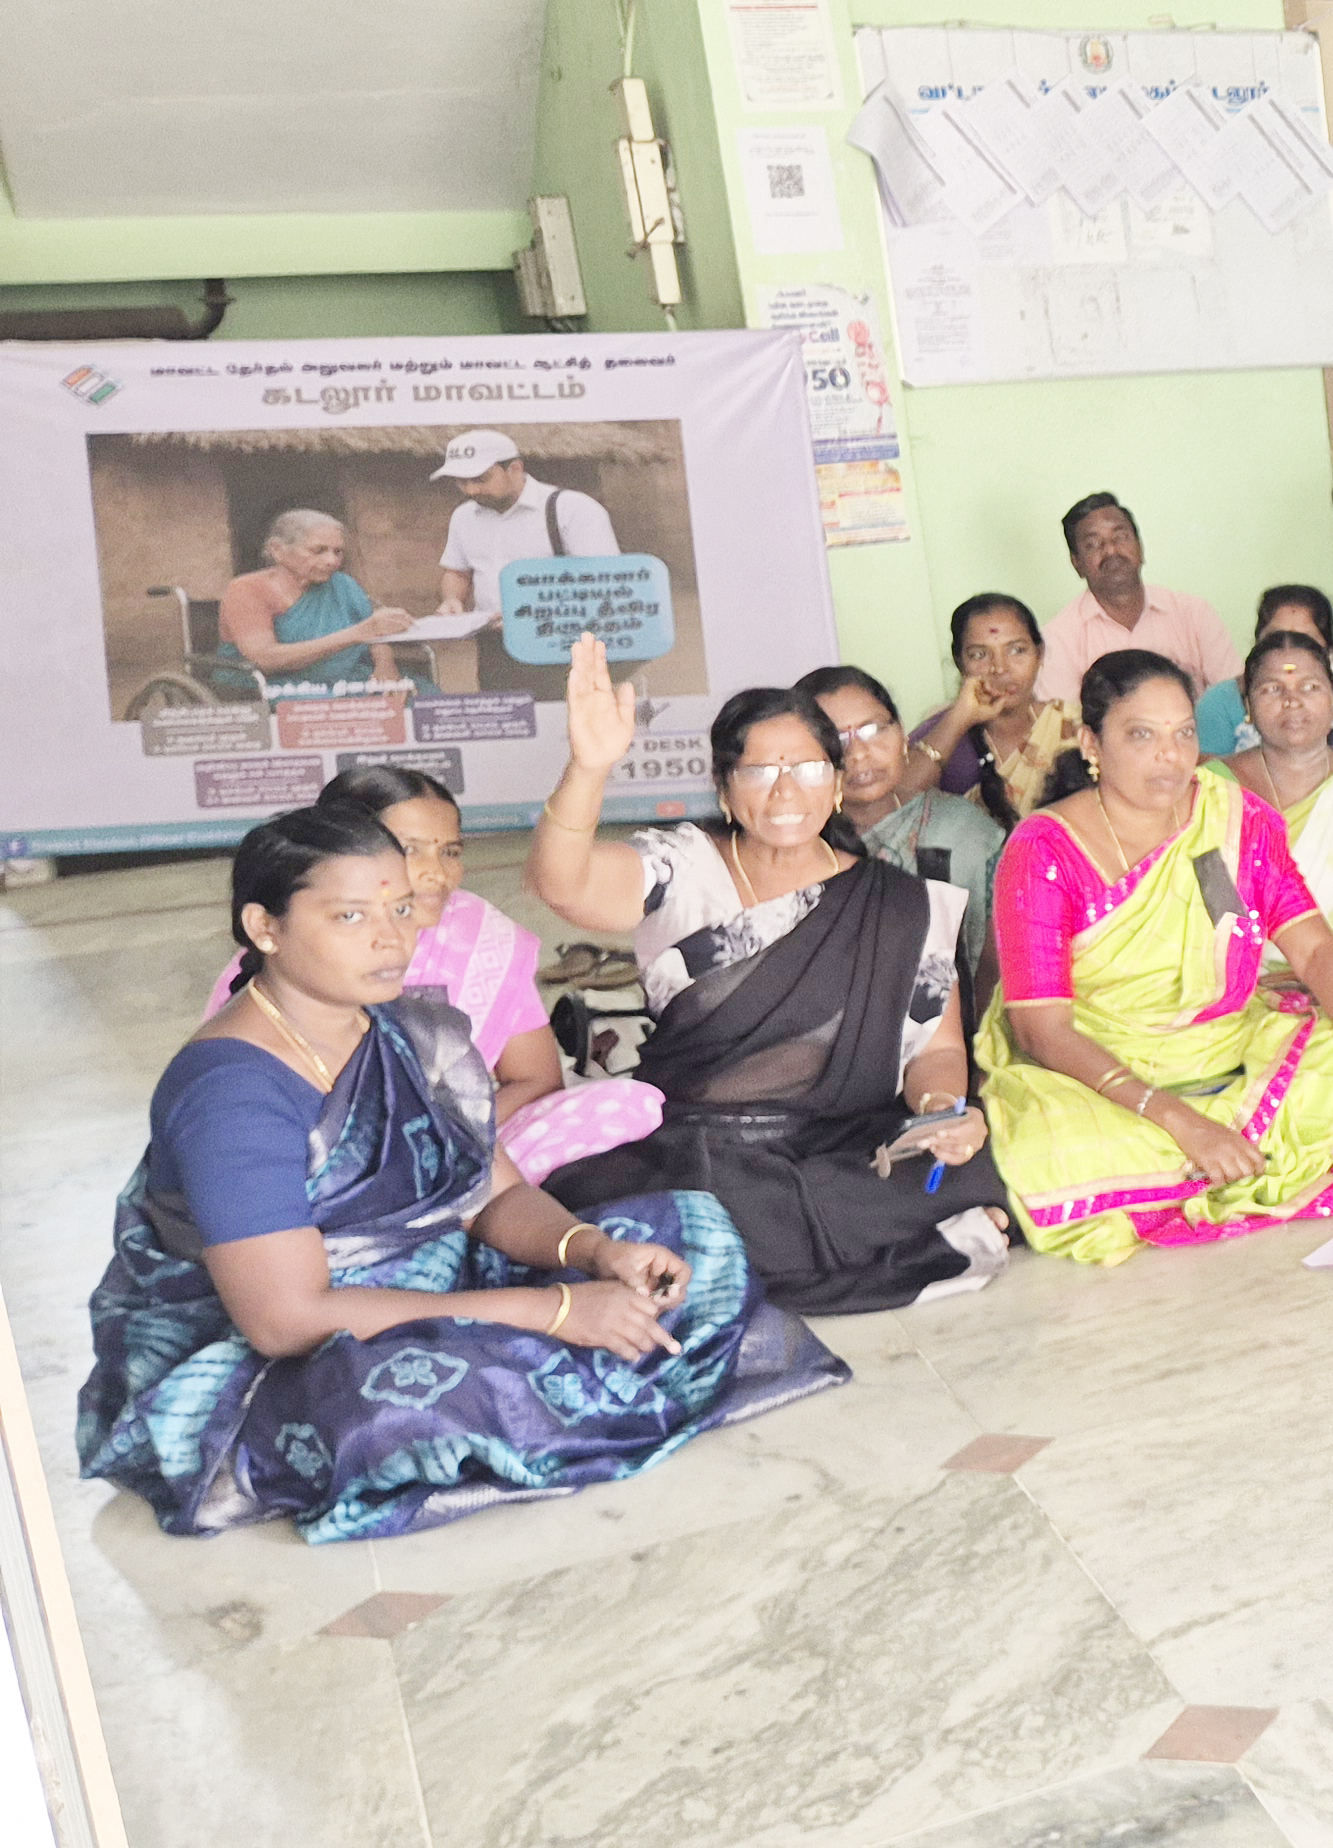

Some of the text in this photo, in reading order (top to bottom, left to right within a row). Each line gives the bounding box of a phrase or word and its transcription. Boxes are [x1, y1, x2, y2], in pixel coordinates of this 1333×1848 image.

[262, 375, 586, 414] கடலூர் மாவட்டம்
[643, 737, 701, 751] DESK
[621, 757, 706, 779] 1950
